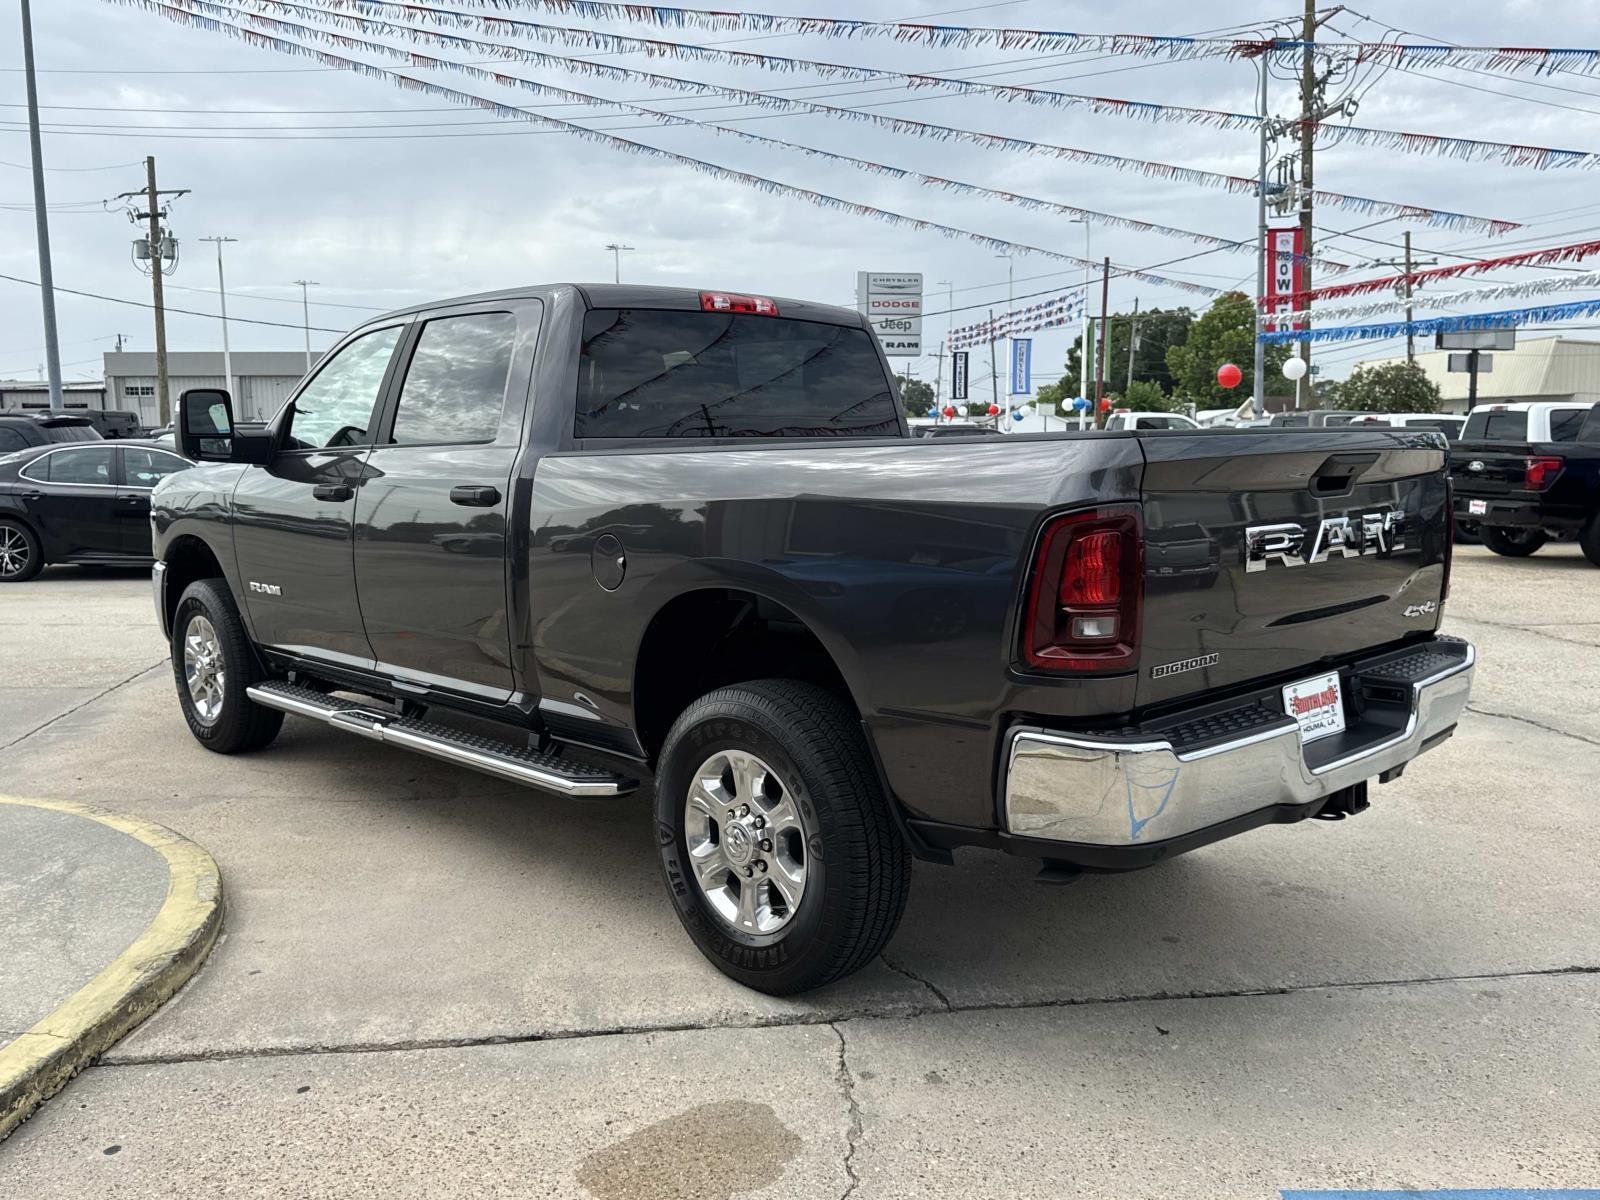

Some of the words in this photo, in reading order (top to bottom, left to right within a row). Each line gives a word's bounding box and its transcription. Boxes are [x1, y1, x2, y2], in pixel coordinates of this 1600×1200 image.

[1276, 263, 1292, 333] OWD
[880, 317, 912, 332] Jeep
[1245, 511, 1405, 573] RAM
[250, 581, 281, 596] RAM
[1153, 653, 1219, 679] BIGHORN
[1327, 718, 1336, 726] LA
